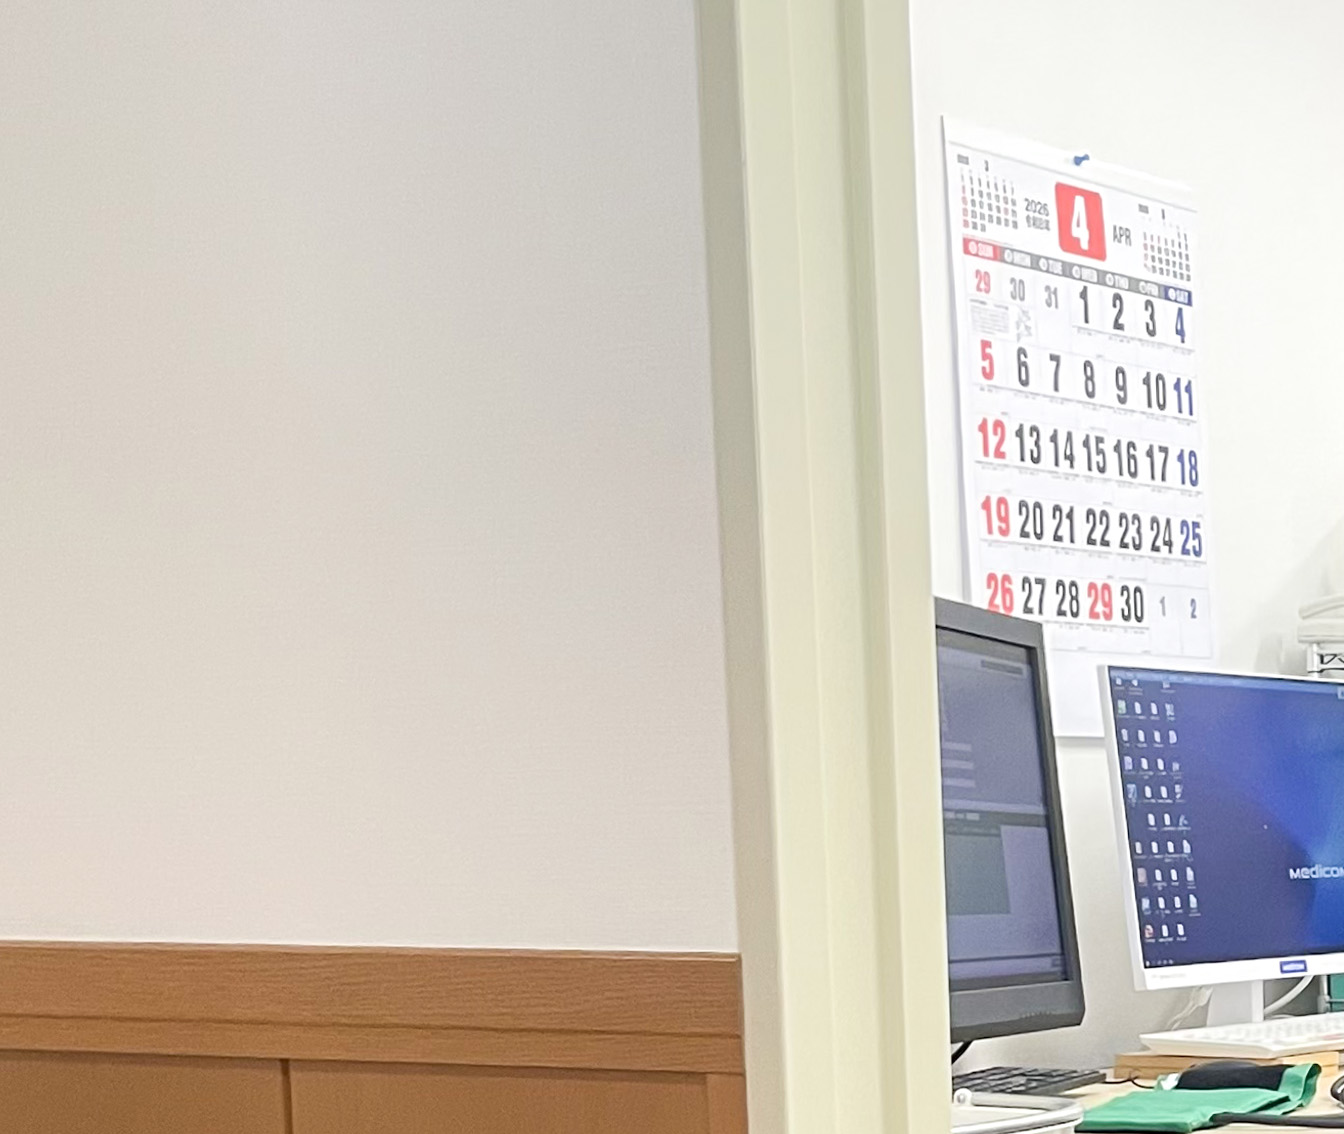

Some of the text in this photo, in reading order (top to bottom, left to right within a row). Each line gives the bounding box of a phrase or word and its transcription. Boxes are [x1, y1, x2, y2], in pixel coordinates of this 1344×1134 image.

[1024, 198, 1049, 217] 2026
[1071, 195, 1090, 251] 4
[1112, 224, 1132, 247] APR
[974, 269, 1186, 344] 29 30 31 1 2 3 4
[980, 339, 1194, 416] 5 6 7 8 9 10 11
[977, 417, 1199, 487] 12 13 14 15 16 17 18
[981, 495, 1202, 557] 19 20 21 22 23 24 25
[986, 572, 1198, 623] 26 27 28 29 30 1 2
